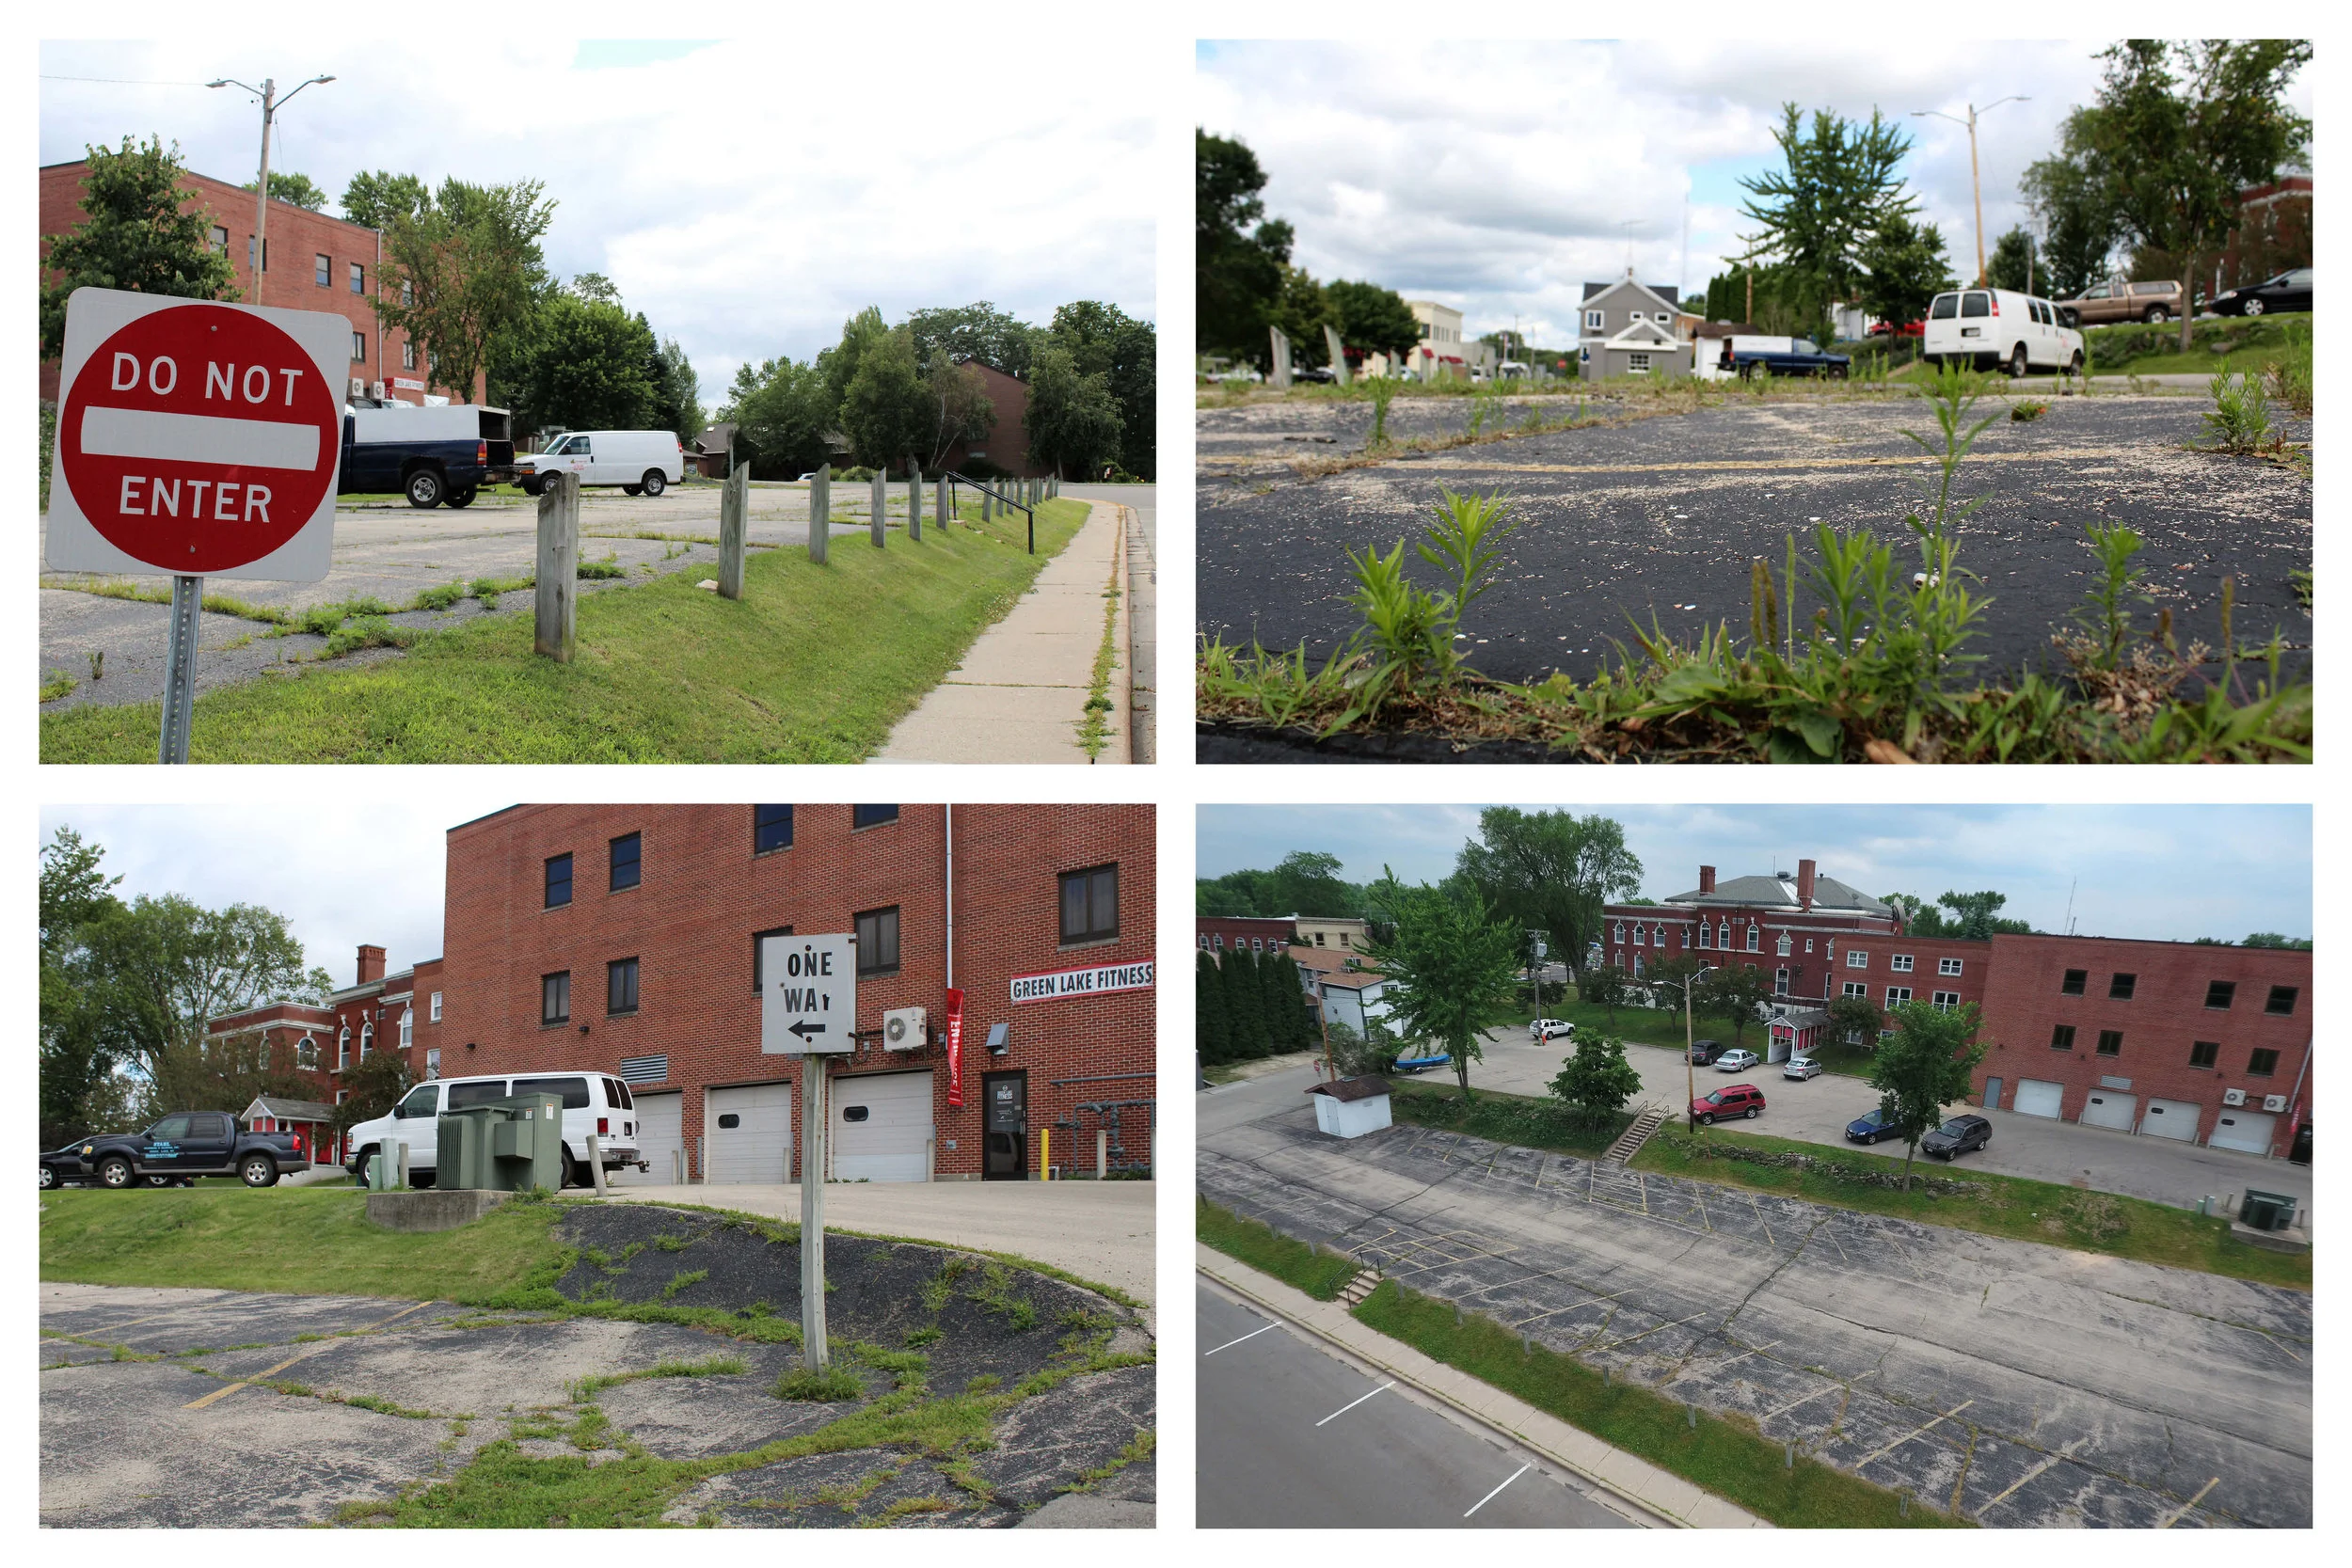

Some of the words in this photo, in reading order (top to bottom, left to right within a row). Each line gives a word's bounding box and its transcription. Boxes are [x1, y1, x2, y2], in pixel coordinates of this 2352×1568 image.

[111, 352, 178, 395] DO
[204, 360, 304, 406] NOT
[119, 475, 272, 523] ENTER
[787, 952, 833, 977] ONE
[1013, 976, 1056, 999] GREEN
[1060, 972, 1092, 993] LAKE
[1097, 964, 1152, 989] FITNESS
